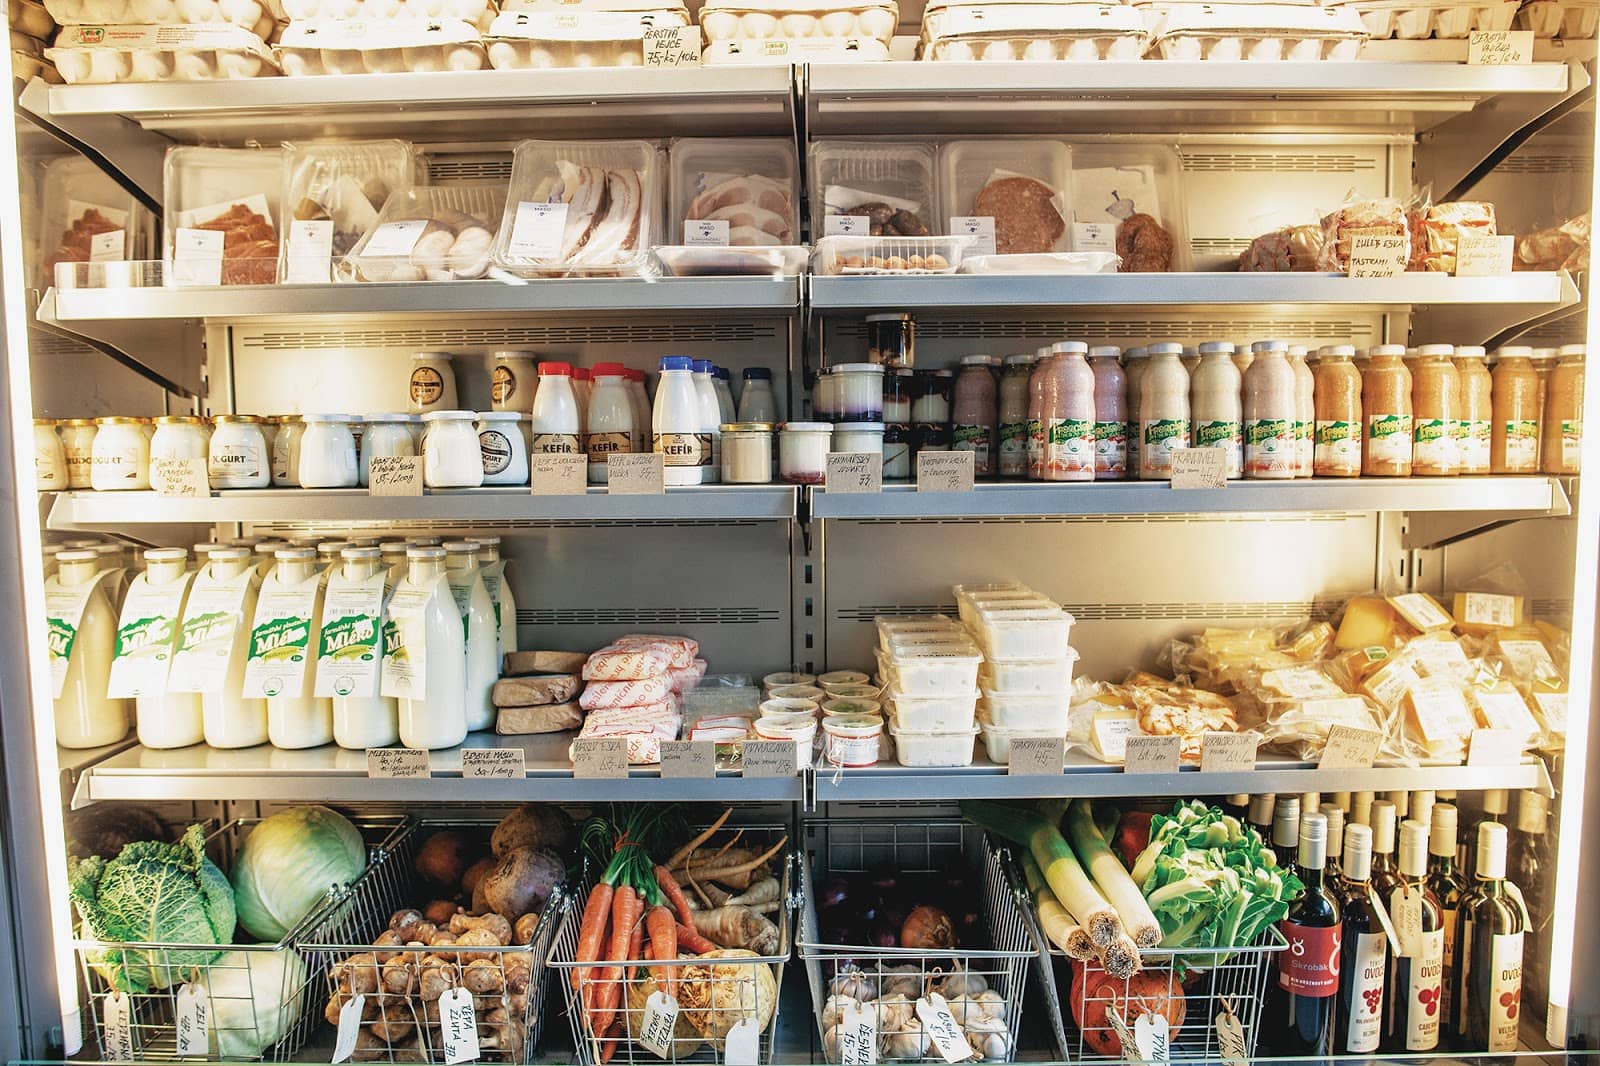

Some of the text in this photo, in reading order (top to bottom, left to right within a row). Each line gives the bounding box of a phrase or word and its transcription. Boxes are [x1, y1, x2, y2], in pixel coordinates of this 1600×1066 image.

[543, 443, 572, 453] KEFÍR
[592, 442, 620, 452] KEFÍR
[663, 444, 693, 455] KEFÍR
